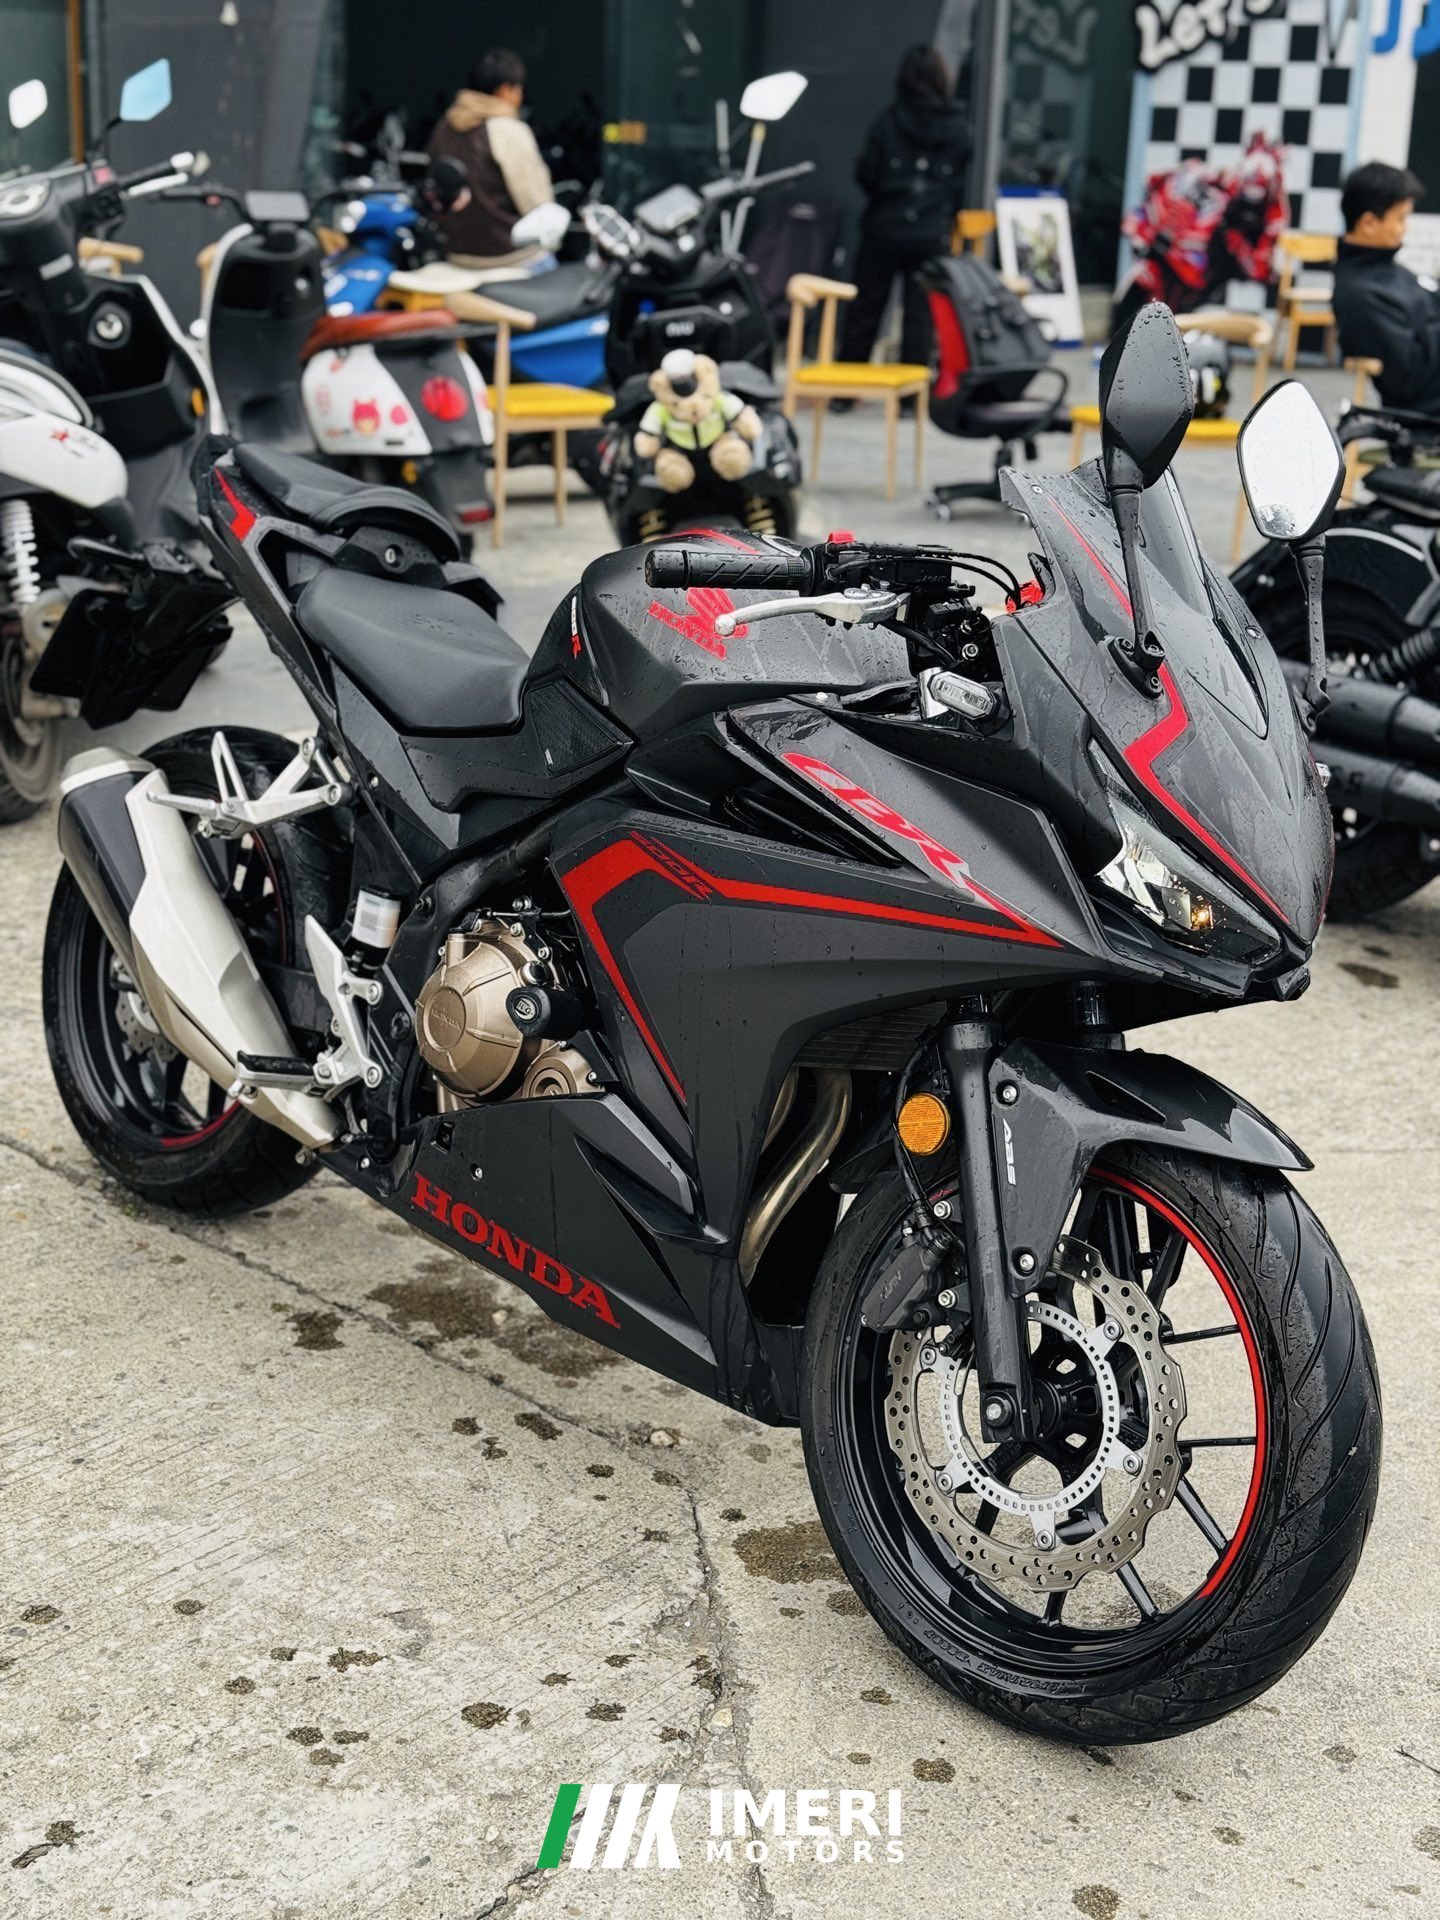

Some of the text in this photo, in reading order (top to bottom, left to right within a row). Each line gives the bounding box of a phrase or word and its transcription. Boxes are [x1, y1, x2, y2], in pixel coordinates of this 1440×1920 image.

[781, 752, 971, 889] CBR
[1002, 1118, 1017, 1186] ABS
[411, 1172, 621, 1329] HONDA
